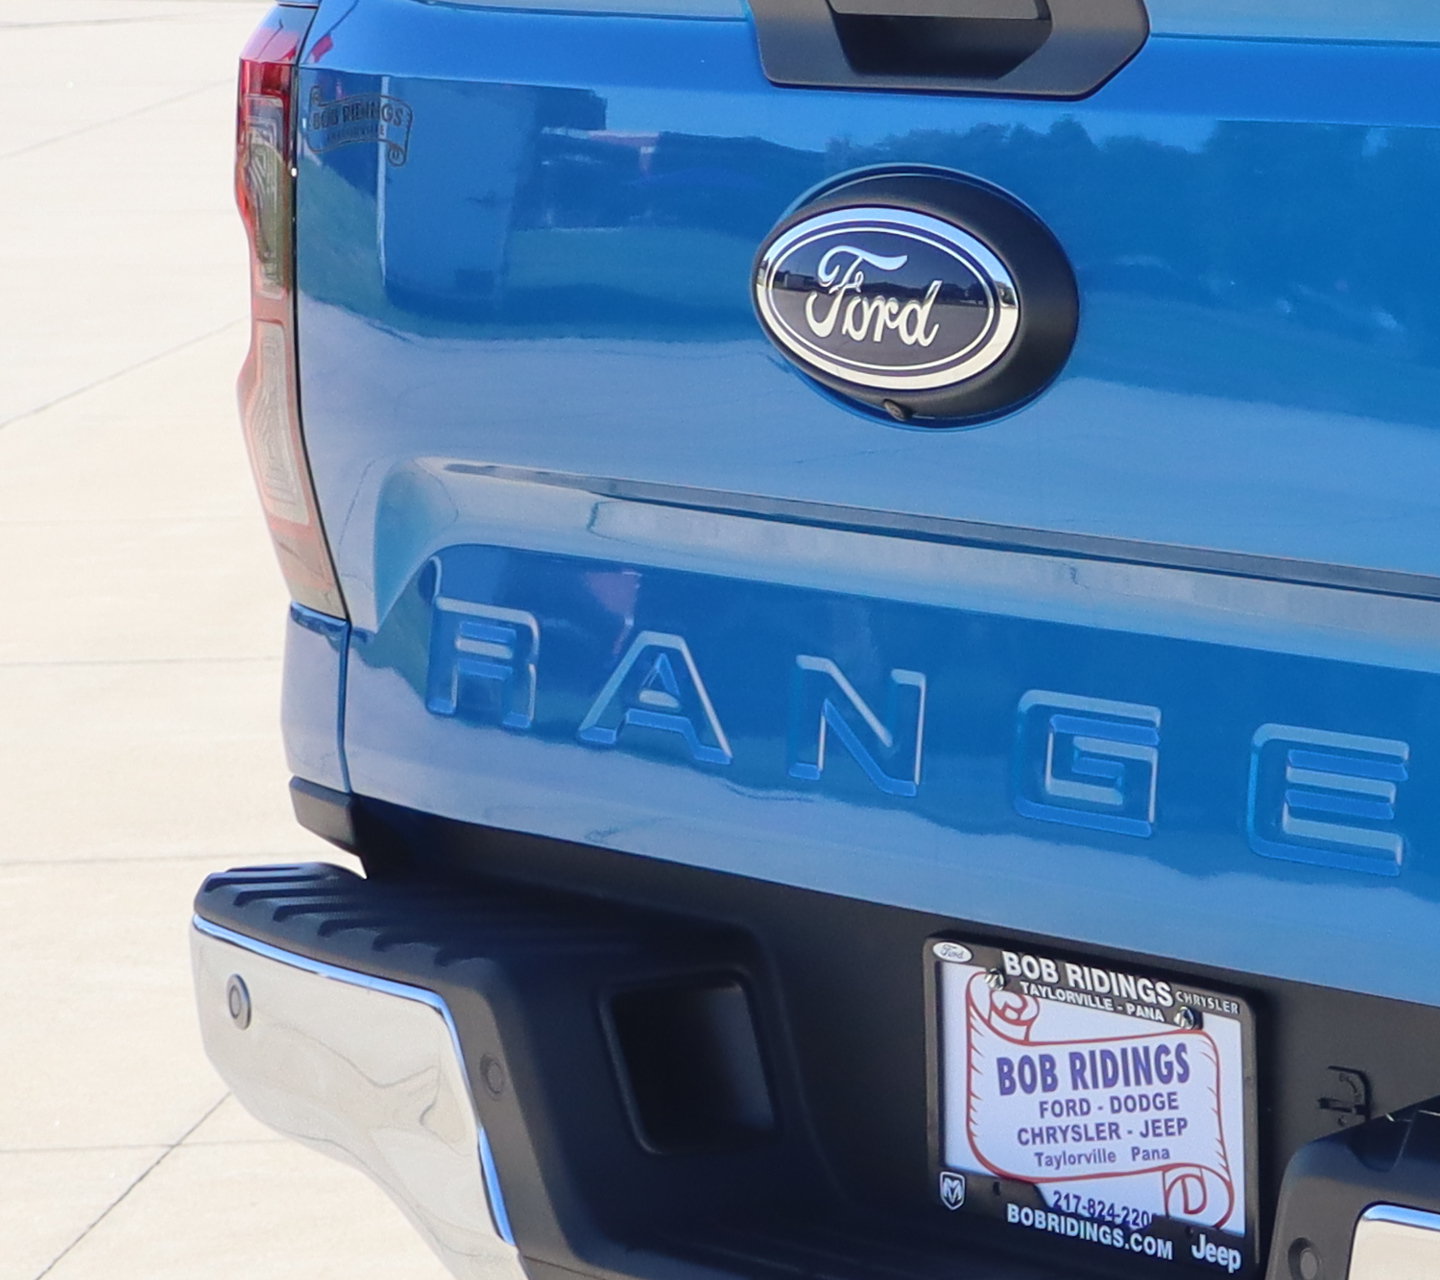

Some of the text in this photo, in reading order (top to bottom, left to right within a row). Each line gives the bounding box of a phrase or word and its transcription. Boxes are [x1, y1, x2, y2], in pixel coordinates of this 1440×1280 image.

[342, 101, 404, 127] RIDINGS
[803, 240, 941, 352] Ford
[1002, 950, 1175, 1008] BOB RIDINGS
[1020, 981, 1114, 1012] TAYLORVILLE
[1127, 1002, 1165, 1023] PANA
[1175, 990, 1239, 1015] CHRYSLER
[996, 1042, 1191, 1095] BOB RIDINGS
[1039, 1099, 1091, 1119] FORD
[1110, 1091, 1179, 1114] DODGE
[1017, 1122, 1121, 1146] CHRYSLER
[1139, 1117, 1188, 1139] JEEP
[1034, 1146, 1170, 1170] Taylorville Pana
[1052, 1189, 1157, 1229] 217-824-220
[1007, 1202, 1174, 1260] BOBRIDINGS.COM
[1191, 1233, 1242, 1274] Jeep
